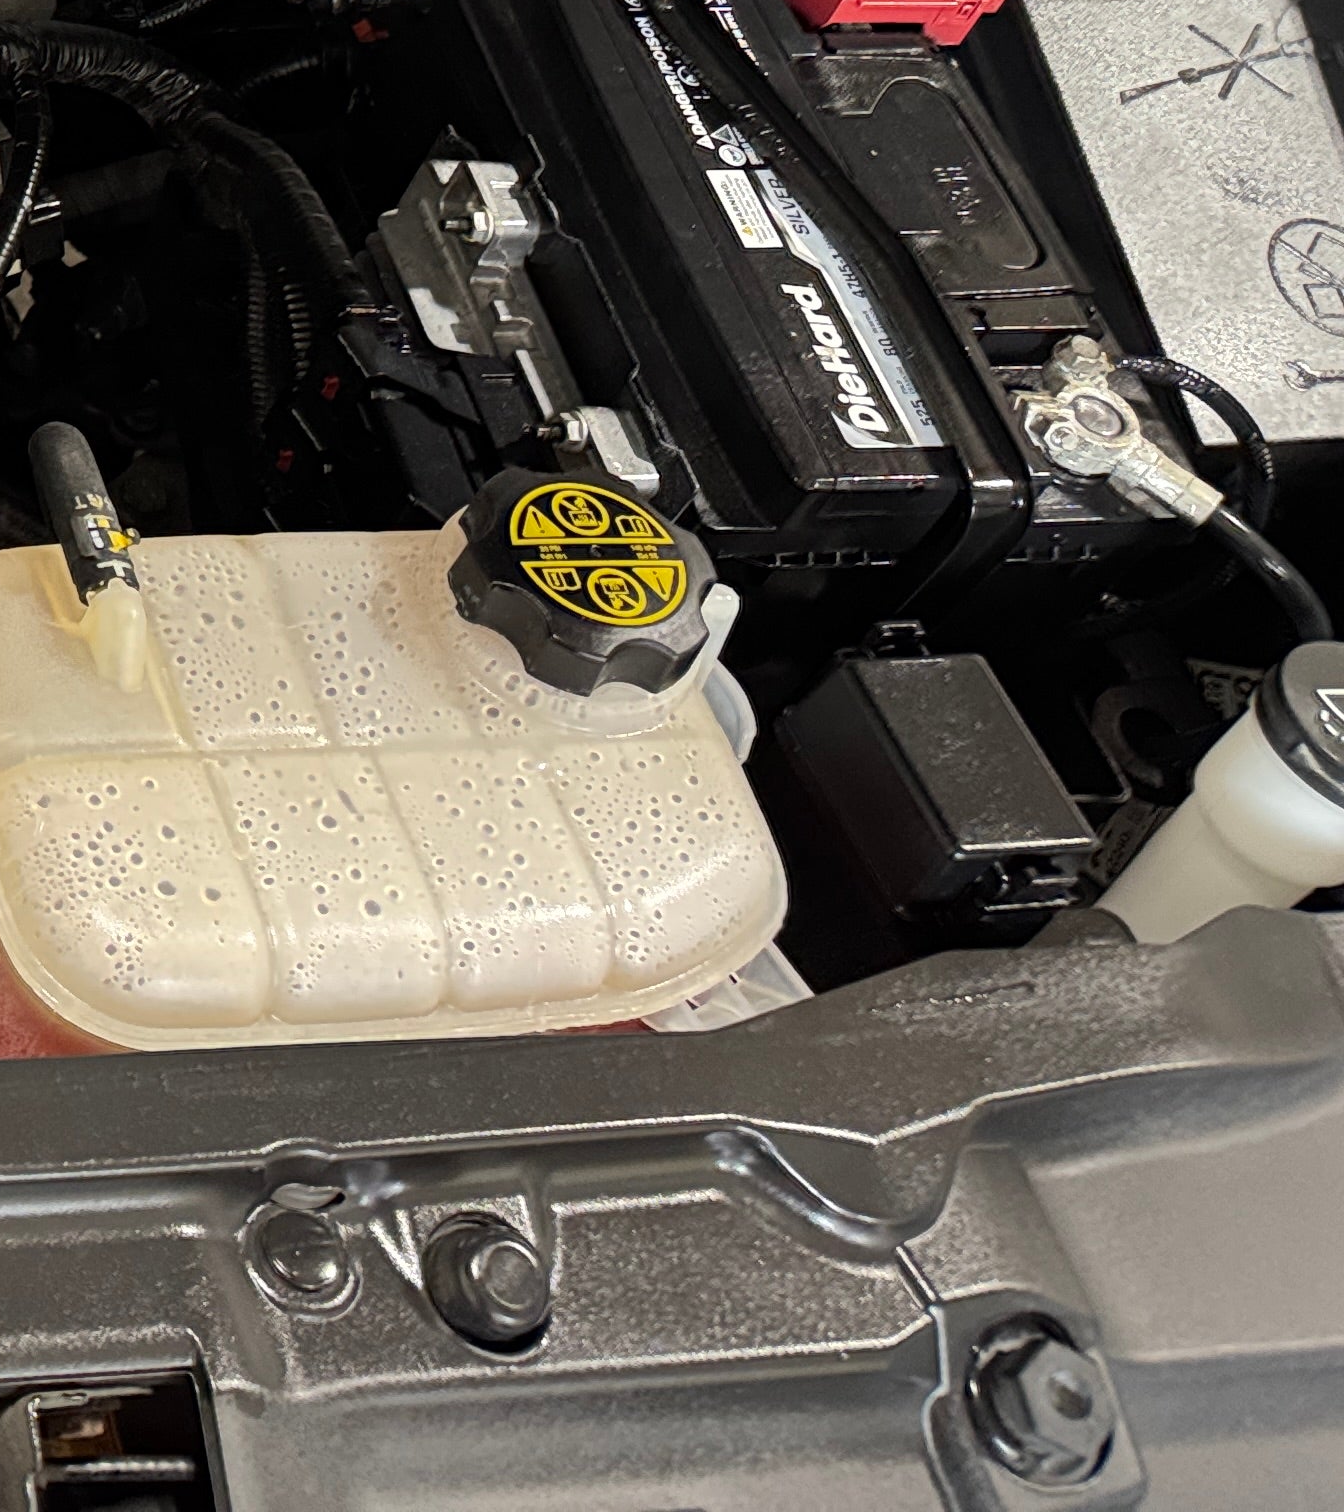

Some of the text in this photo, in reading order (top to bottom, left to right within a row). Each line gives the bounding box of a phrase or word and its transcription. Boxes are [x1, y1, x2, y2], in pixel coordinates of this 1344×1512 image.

[634, 17, 708, 135] DANGER/POISON
[768, 178, 810, 235] SILVER
[780, 284, 890, 432] DieHard
